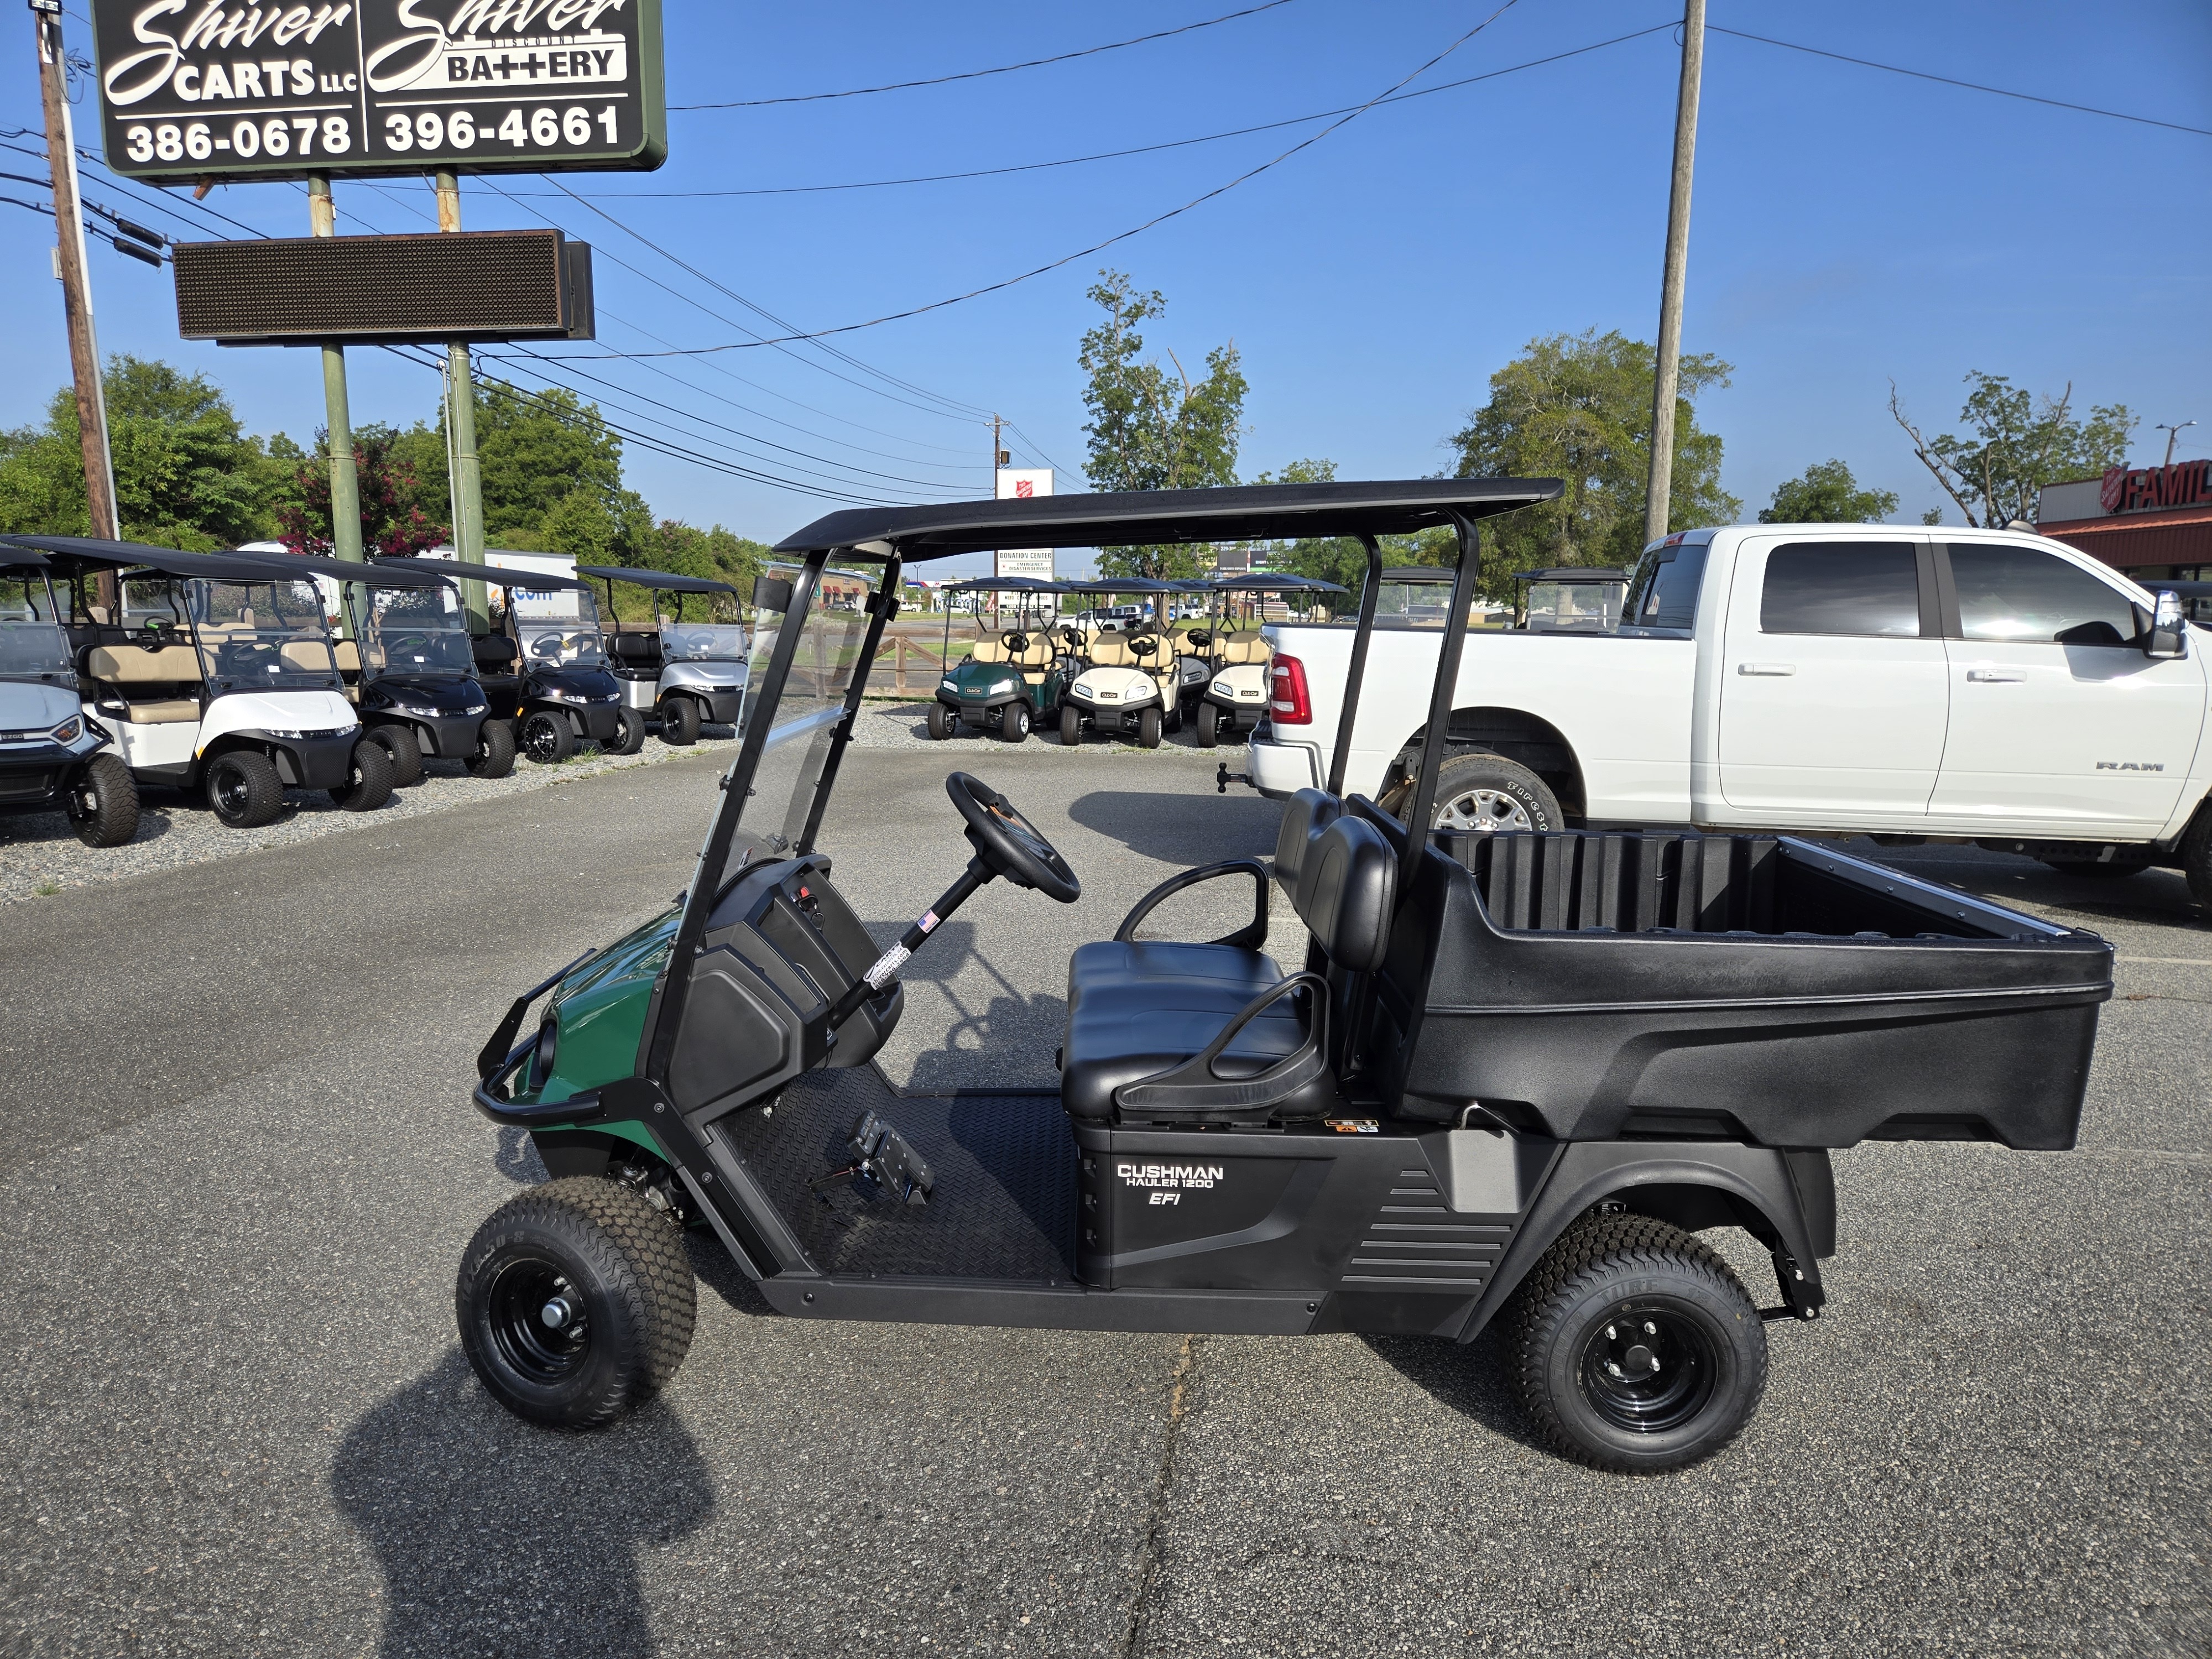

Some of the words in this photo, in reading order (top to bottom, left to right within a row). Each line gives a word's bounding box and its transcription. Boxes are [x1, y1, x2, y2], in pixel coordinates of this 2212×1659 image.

[105, 0, 352, 105] Shiver
[366, 0, 628, 92] Shiver
[491, 35, 577, 48] DISCOUNT
[174, 59, 315, 101] CARTS
[321, 74, 357, 93] LLC
[127, 117, 351, 162] 386-0678
[385, 105, 618, 152] 396-4661
[2101, 472, 2122, 502] SALVATION
[2106, 469, 2115, 485] THE
[2107, 486, 2120, 507] ARMY
[2096, 761, 2164, 771] RAM
[872, 949, 908, 985] shivercarts.com
[1117, 1165, 1223, 1180] CUSHMAN
[1126, 1178, 1178, 1187] HAULER
[1182, 1180, 1214, 1188] 1200
[1149, 1193, 1181, 1206] EFI
[1551, 1311, 1589, 1383] SUPER
[1597, 1279, 1658, 1308] TURF
